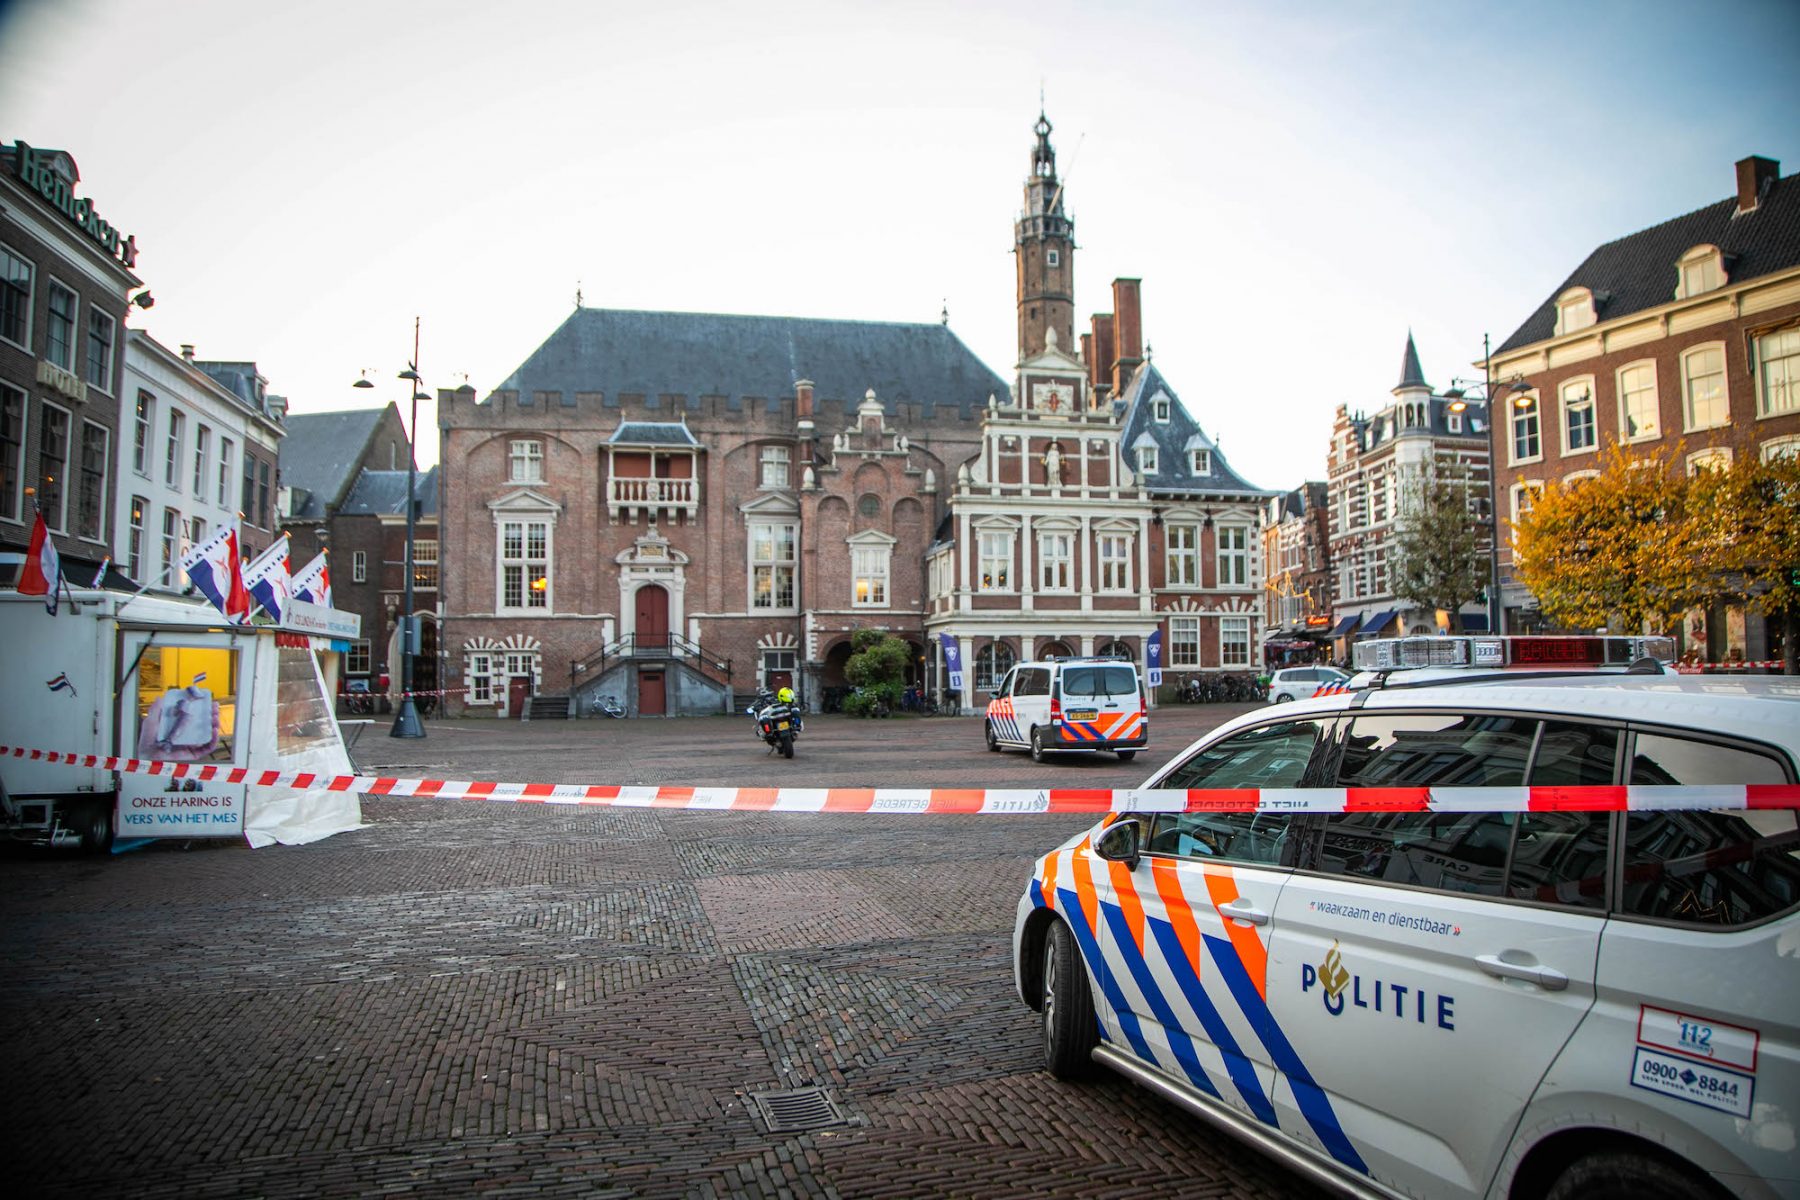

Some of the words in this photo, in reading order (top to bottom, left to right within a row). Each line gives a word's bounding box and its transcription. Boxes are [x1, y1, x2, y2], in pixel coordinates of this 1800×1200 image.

[14, 139, 121, 254] Heineken
[37, 361, 88, 402] HOTEL
[184, 531, 229, 568] HARIN
[124, 814, 153, 825] VERS
[157, 813, 183, 824] VAN
[186, 813, 209, 824] HET
[212, 812, 238, 823] MES
[132, 797, 166, 808] ONZE
[170, 797, 218, 807] HARING
[222, 796, 232, 807] IS
[1372, 911, 1386, 923] en
[1302, 963, 1455, 1031] POLITIE
[1643, 1060, 1678, 1080] 0900
[1698, 1075, 1739, 1098] 8844
[1707, 1092, 1739, 1106] POLITIE
